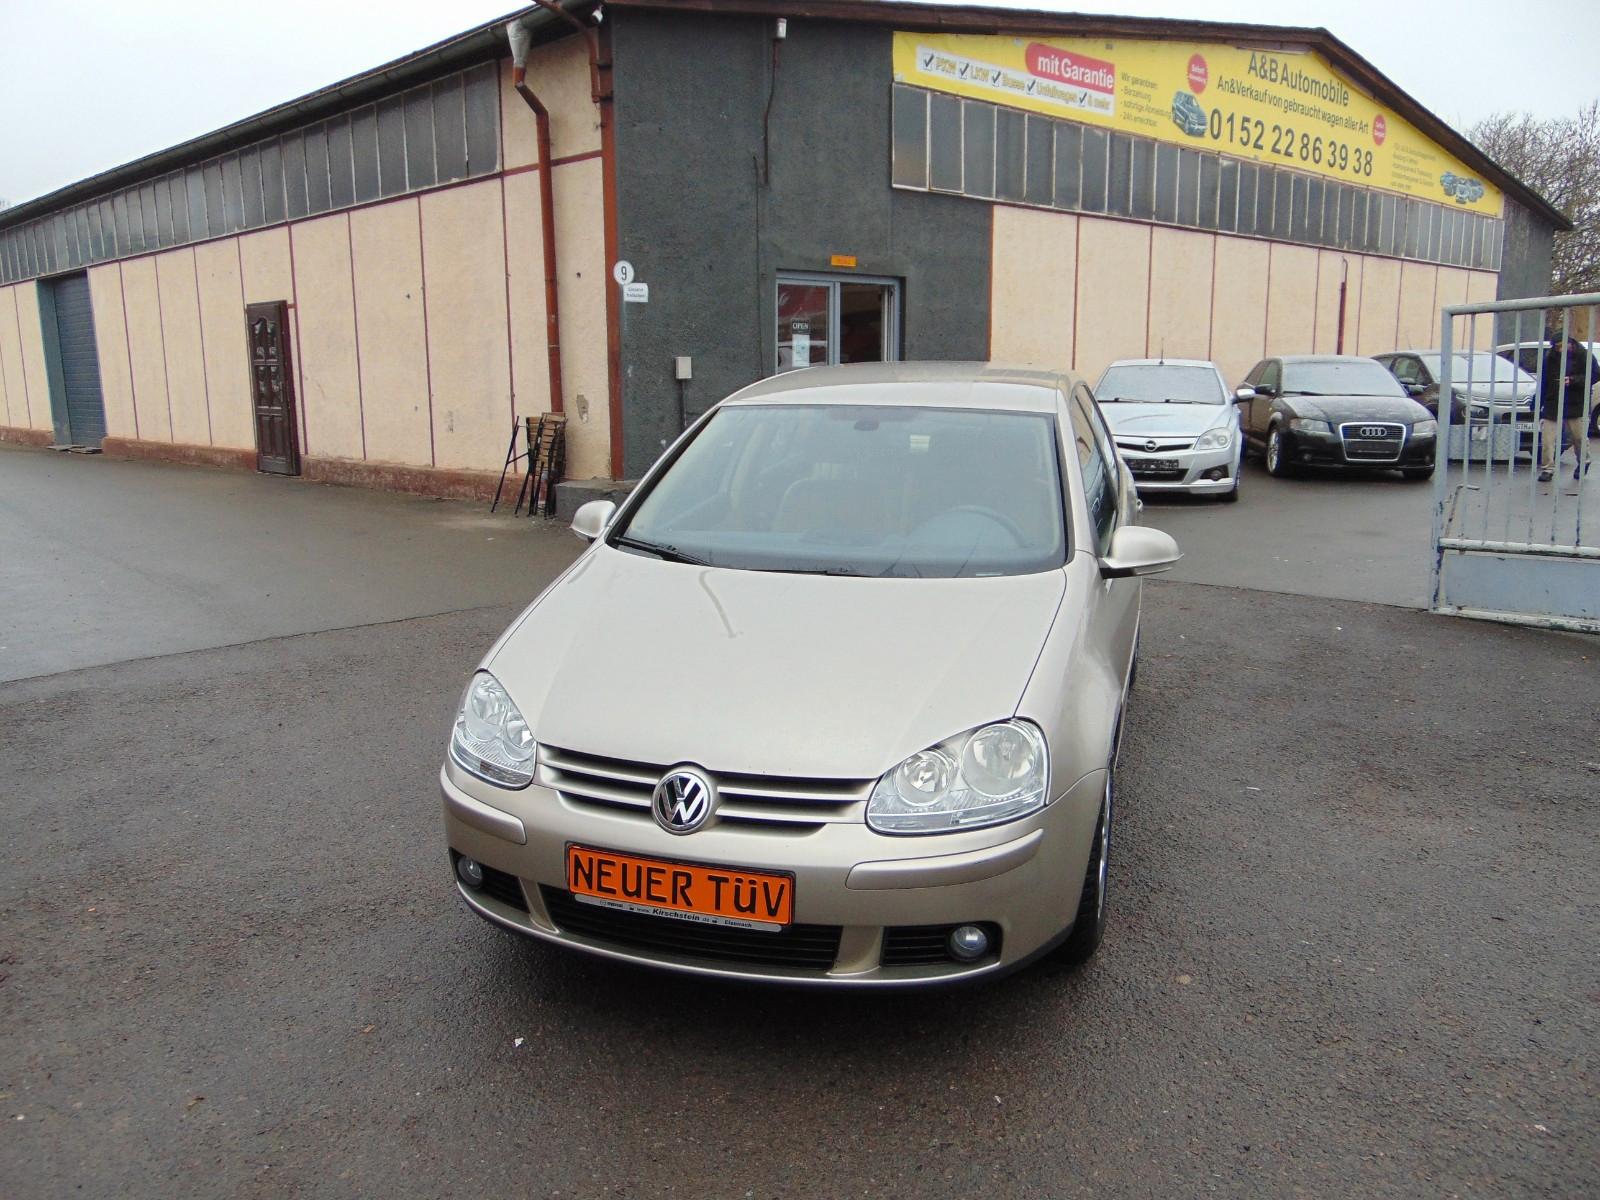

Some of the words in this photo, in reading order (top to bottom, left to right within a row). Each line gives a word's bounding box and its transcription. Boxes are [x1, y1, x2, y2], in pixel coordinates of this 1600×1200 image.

[1038, 54, 1060, 76] mit
[1061, 58, 1114, 89] Garantie
[1248, 52, 1278, 83] A&B
[1280, 63, 1349, 107] Automobile
[1344, 116, 1359, 130] aller
[1358, 119, 1369, 134] Art
[1209, 108, 1265, 150] 0152
[1271, 124, 1296, 158] 22
[1299, 133, 1323, 165] 86
[1327, 139, 1348, 171] 39
[1352, 147, 1373, 177] 38
[621, 265, 628, 281] 9
[792, 322, 809, 330] OPEN
[573, 853, 693, 907] NEUER
[652, 907, 701, 922] Kirschstein
